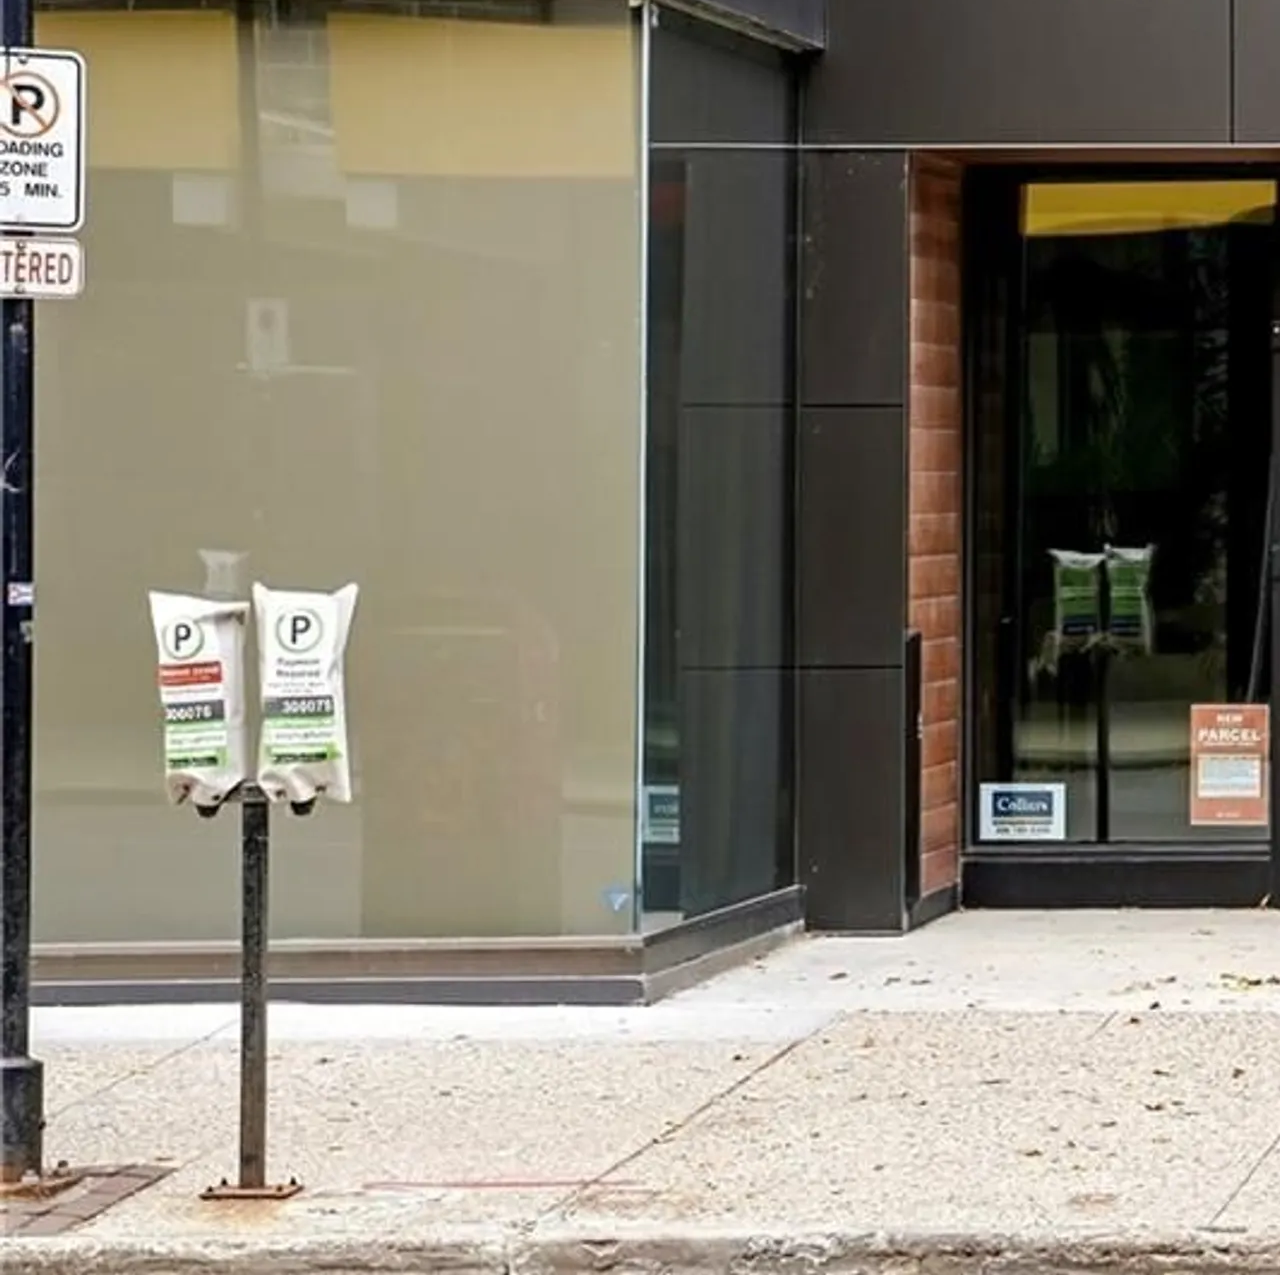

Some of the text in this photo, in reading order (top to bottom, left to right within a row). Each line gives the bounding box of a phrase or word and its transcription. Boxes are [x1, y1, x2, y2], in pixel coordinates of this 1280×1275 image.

[174, 623, 192, 652] P
[291, 615, 312, 645] P
[1198, 727, 1261, 742] PARCEL
